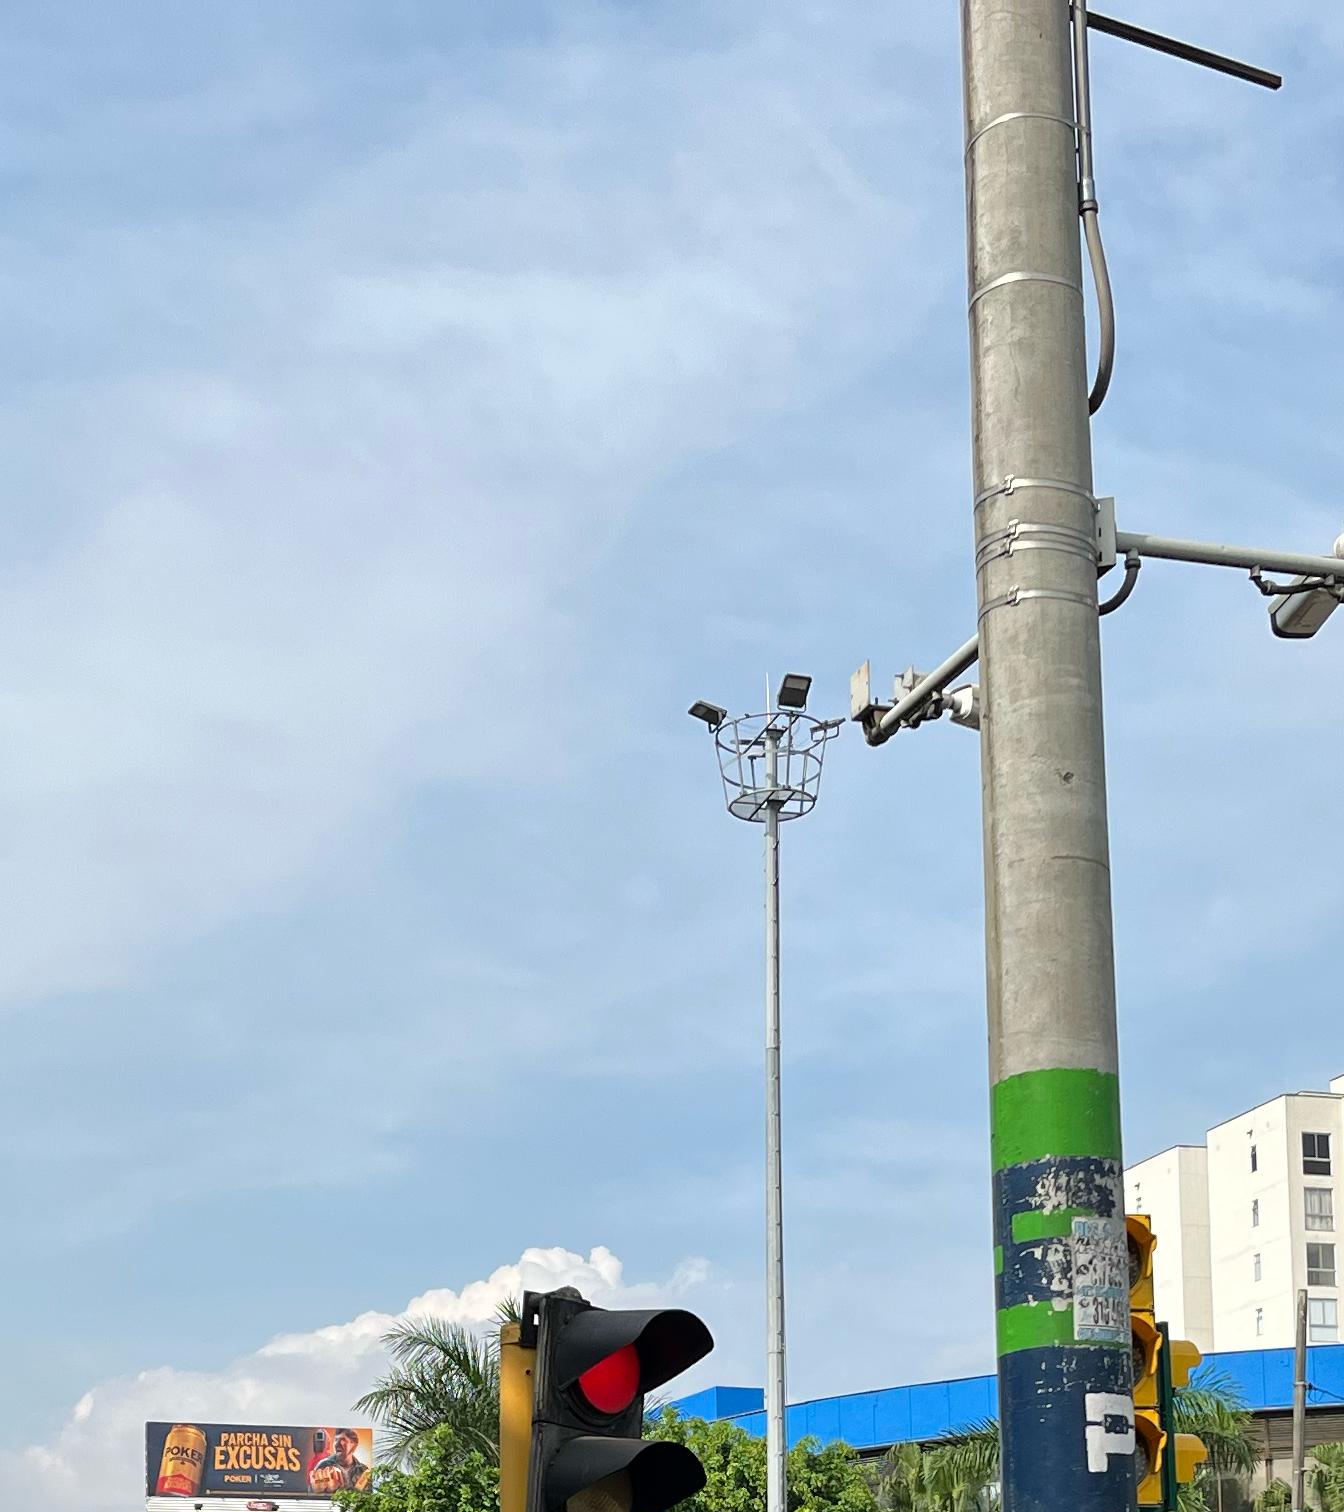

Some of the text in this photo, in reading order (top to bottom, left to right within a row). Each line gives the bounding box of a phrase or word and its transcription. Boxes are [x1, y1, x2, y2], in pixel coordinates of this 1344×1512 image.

[220, 1432, 292, 1448] PARCHA SIN
[214, 1445, 301, 1472] EXCUSAS
[224, 1474, 252, 1484] POKER
